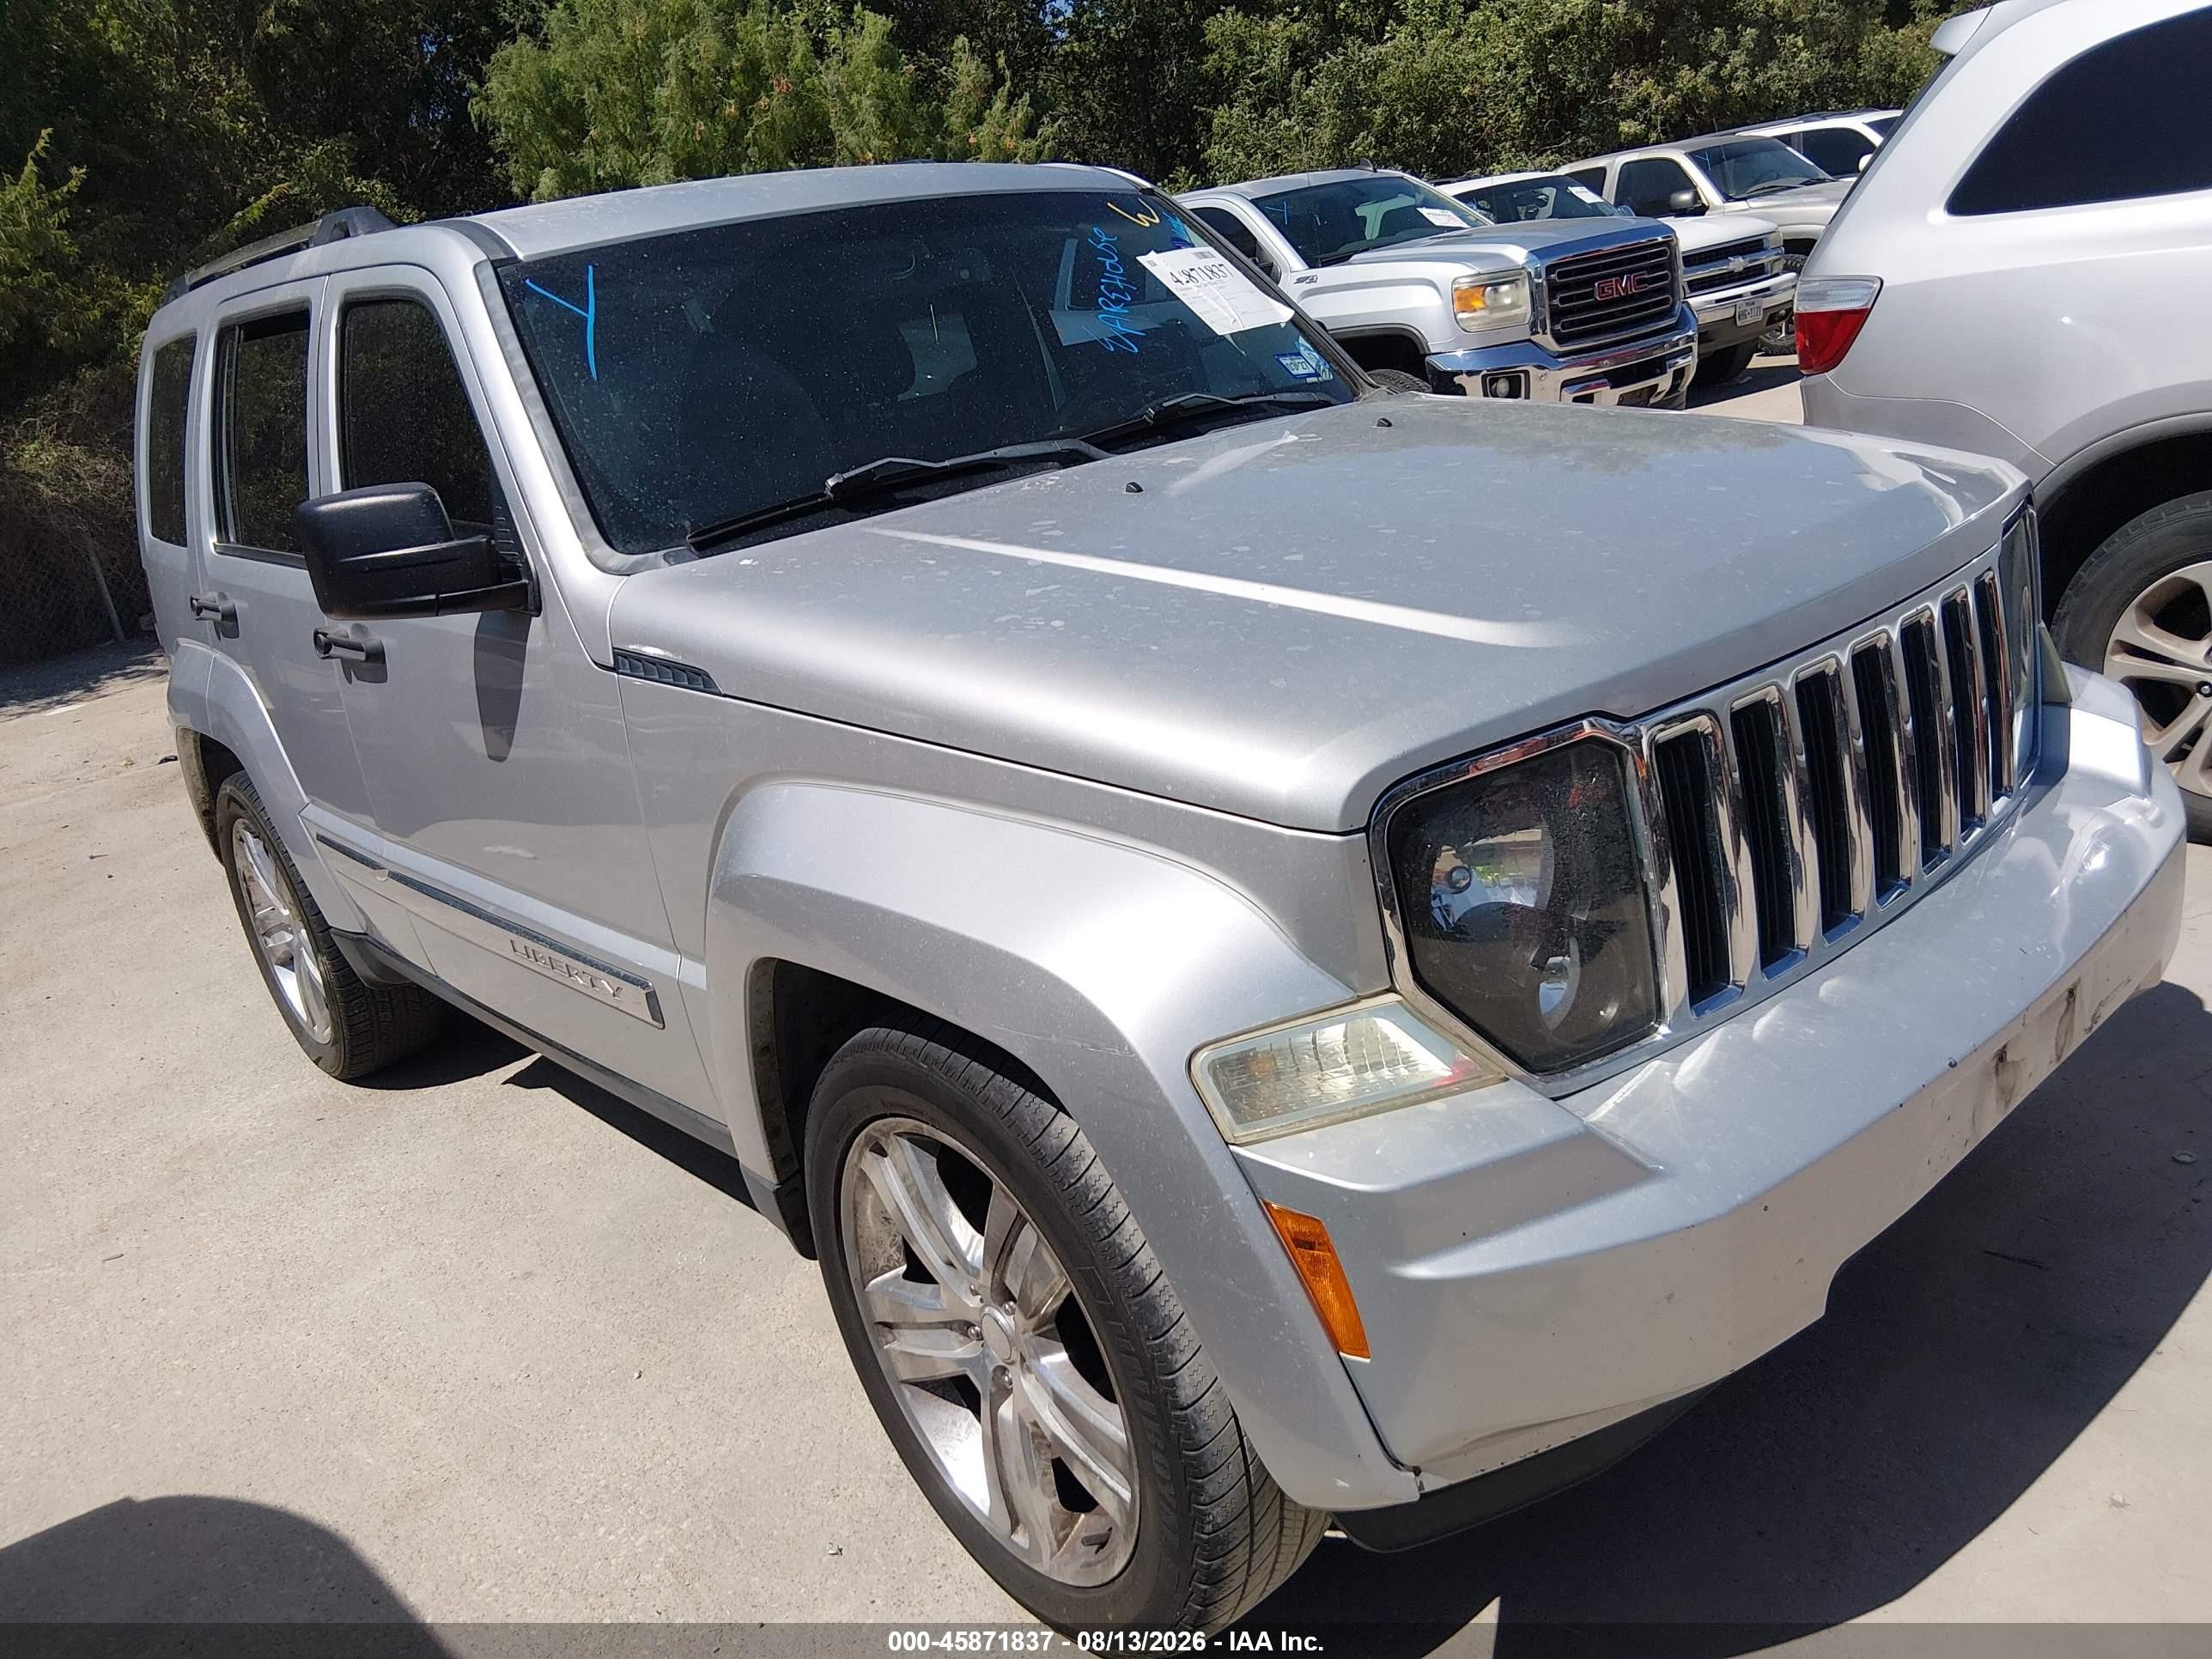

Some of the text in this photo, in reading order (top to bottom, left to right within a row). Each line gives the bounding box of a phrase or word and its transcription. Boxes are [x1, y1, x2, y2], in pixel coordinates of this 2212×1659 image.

[1595, 270, 1649, 301] GMC
[525, 264, 598, 381] Y
[510, 939, 623, 1000] LIBERTY
